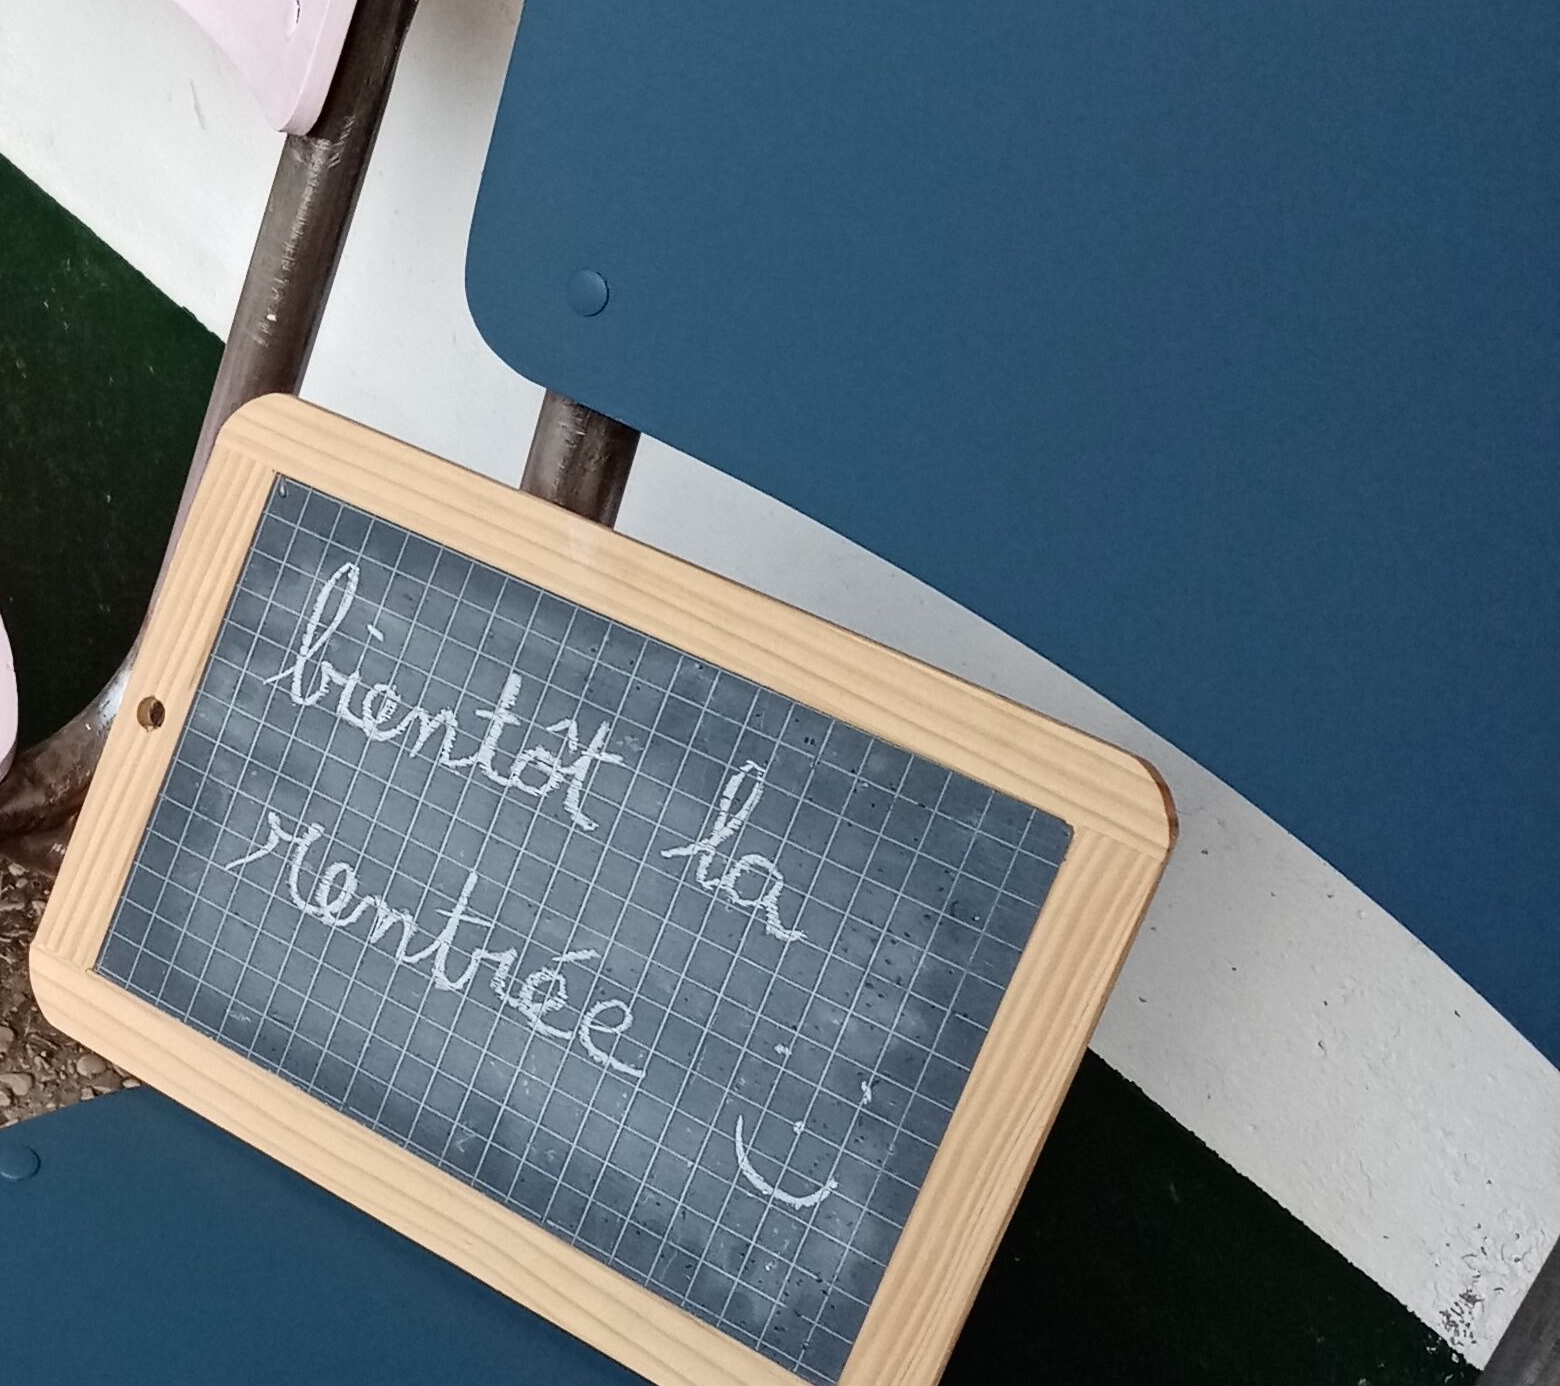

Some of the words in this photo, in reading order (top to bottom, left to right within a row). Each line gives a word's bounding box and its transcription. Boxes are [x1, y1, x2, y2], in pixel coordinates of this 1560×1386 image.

[263, 562, 624, 832] bientôt
[661, 759, 806, 943] la
[225, 806, 645, 1077] rentrée
